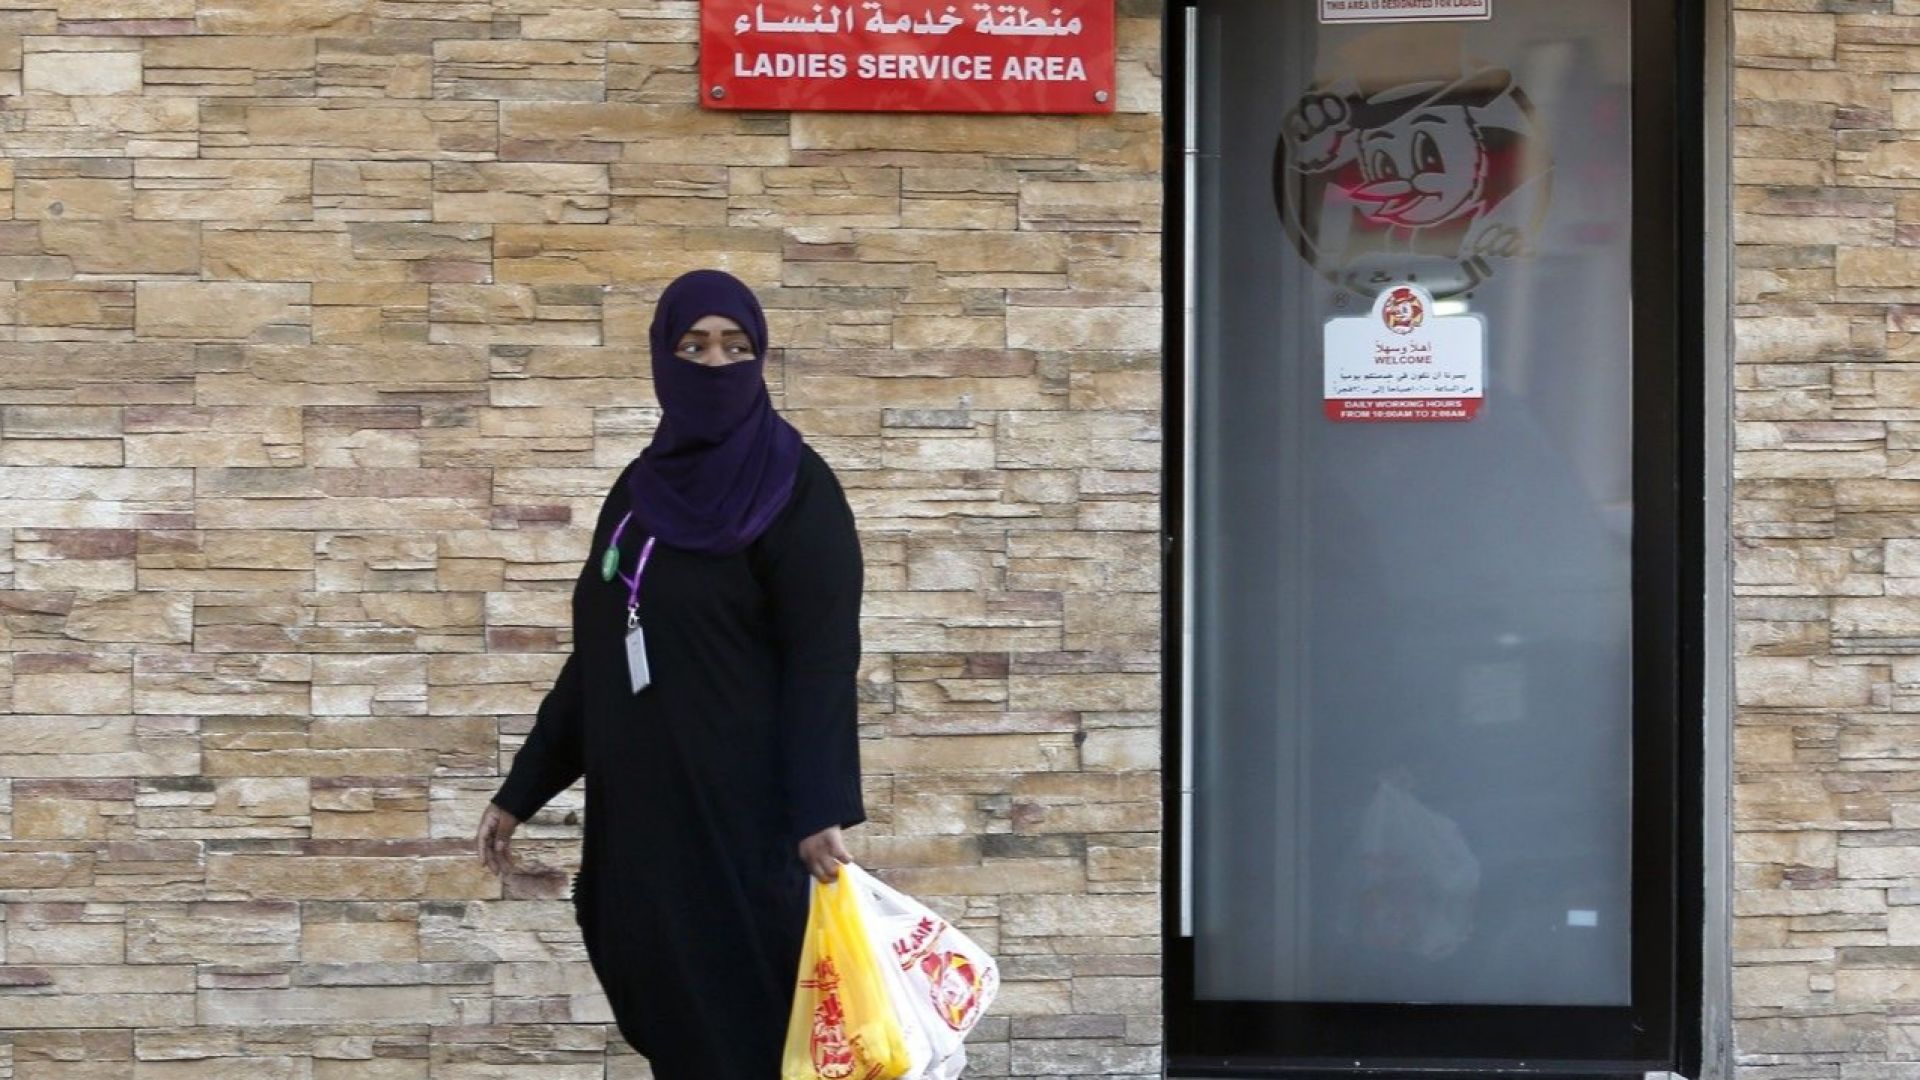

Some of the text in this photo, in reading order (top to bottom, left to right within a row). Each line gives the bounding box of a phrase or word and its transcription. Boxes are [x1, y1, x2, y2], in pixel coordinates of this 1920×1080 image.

[1327, 1, 1345, 9] THIS
[1348, 1, 1369, 9] AREA
[734, 2, 1082, 36] منطقة خدمة النساء
[734, 53, 1087, 81] LADIES SERVICE AREA
[1375, 355, 1432, 365] WELCOME
[1344, 400, 1463, 408] DAILY WORKING HOURS
[1340, 410, 1370, 418] FROM
[1415, 410, 1429, 418] TO
